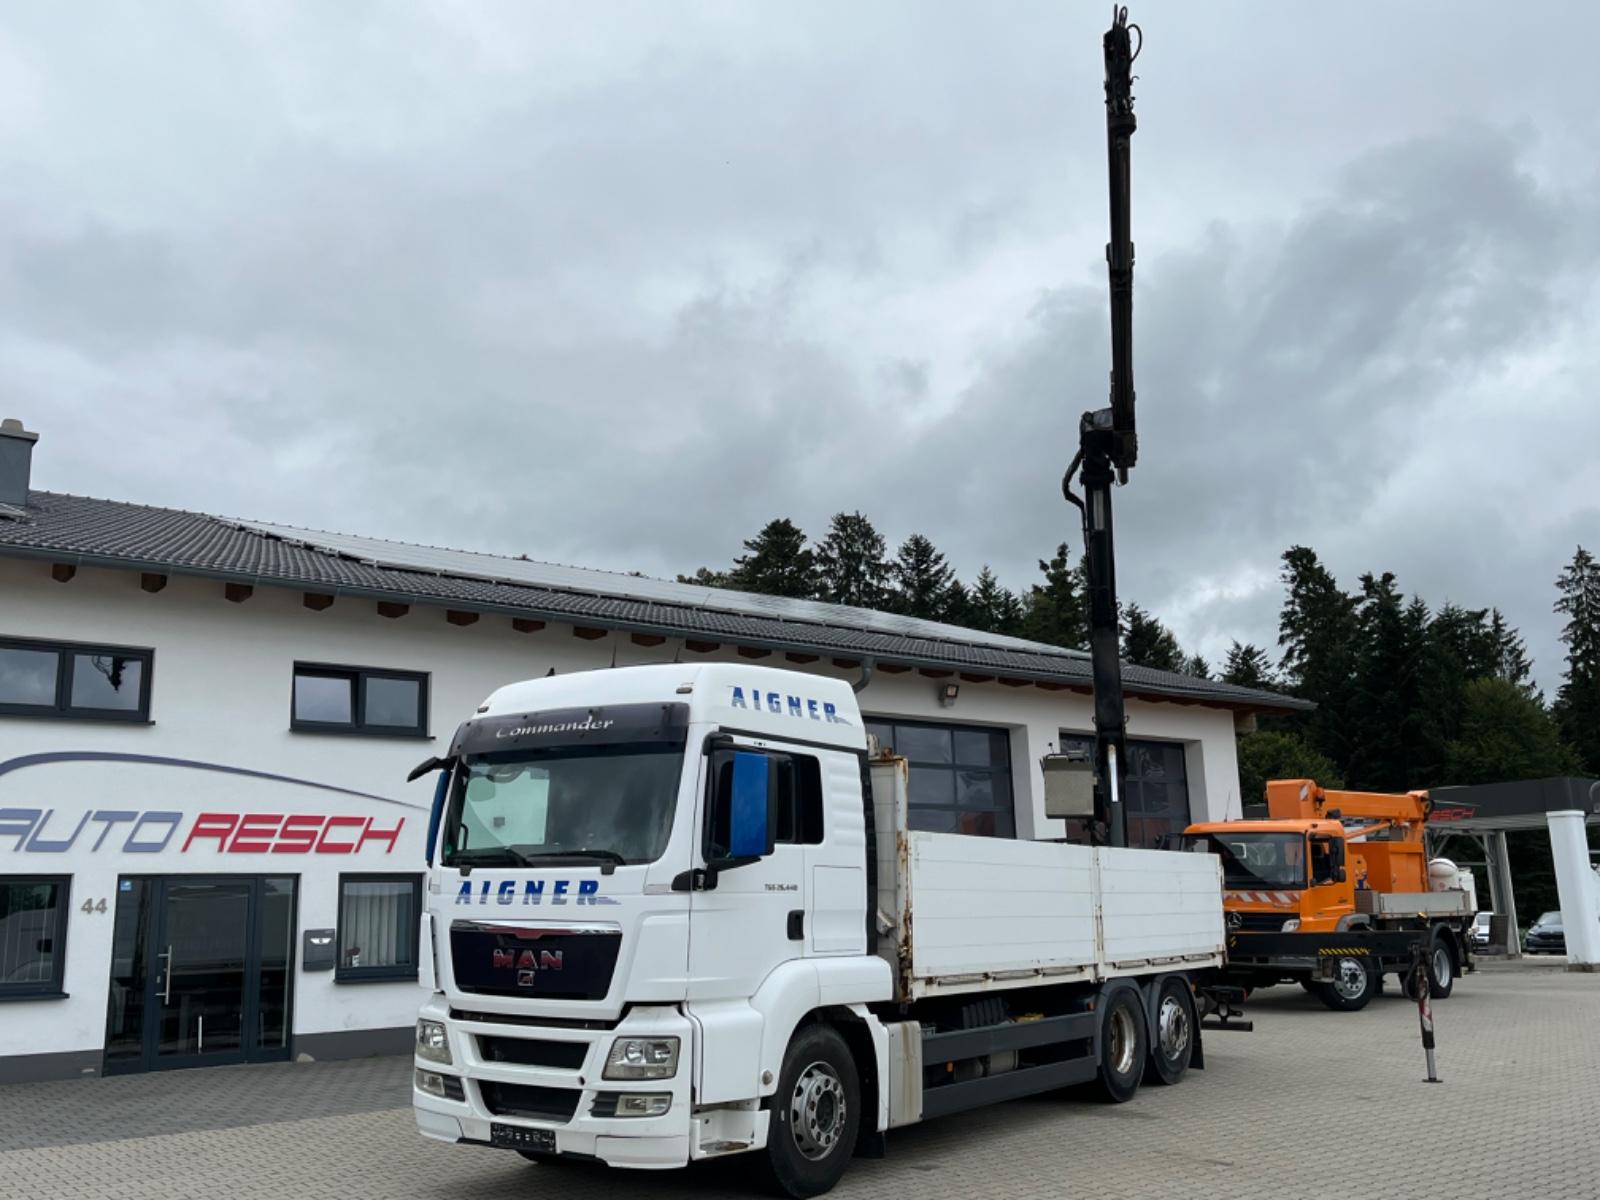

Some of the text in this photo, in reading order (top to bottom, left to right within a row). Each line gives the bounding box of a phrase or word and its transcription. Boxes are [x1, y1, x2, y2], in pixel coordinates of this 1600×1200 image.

[731, 686, 837, 723] AIGNER
[496, 715, 614, 738] Commander
[1429, 807, 1475, 822] ESCH
[0, 808, 405, 853] AUTO RESCH
[455, 880, 599, 905] AIGNER
[81, 898, 107, 914] 44
[493, 949, 563, 969] MAN
